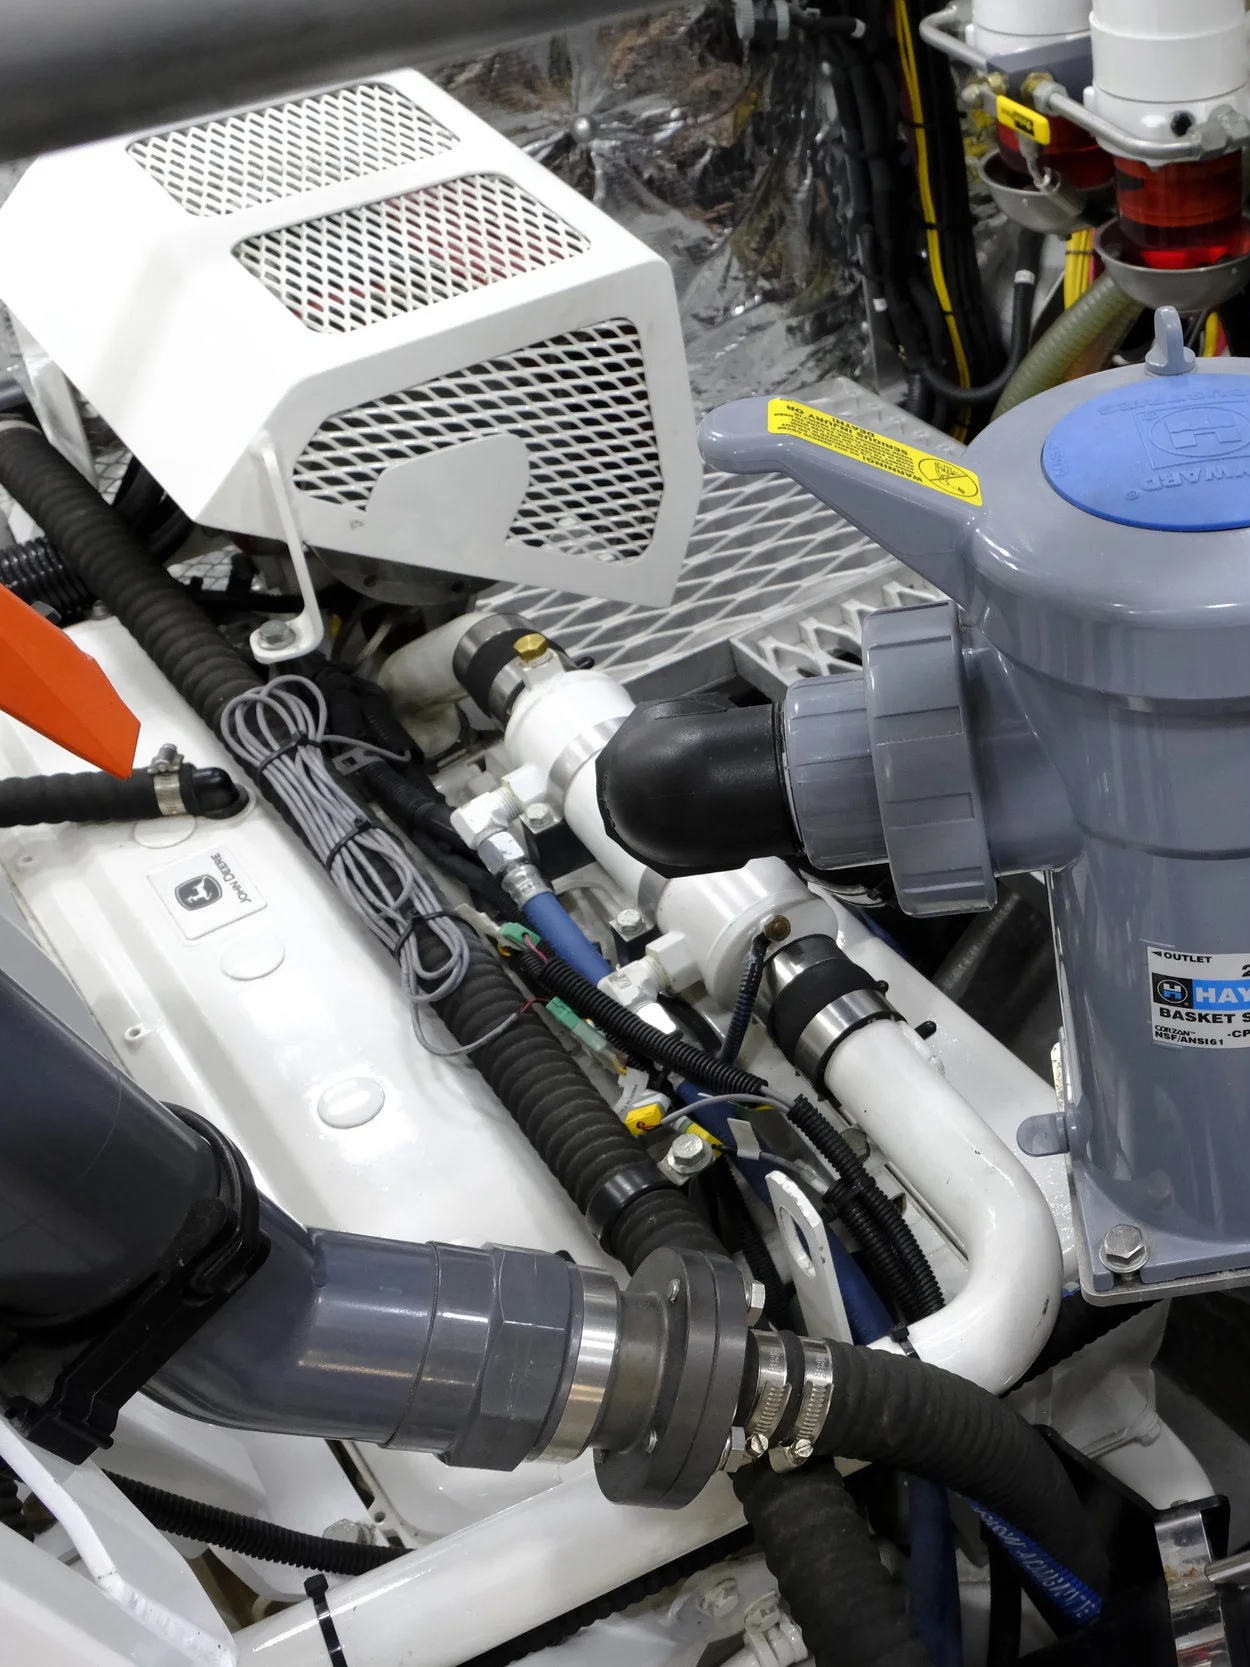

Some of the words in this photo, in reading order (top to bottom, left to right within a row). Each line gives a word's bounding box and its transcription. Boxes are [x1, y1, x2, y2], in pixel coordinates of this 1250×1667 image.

[786, 404, 804, 415] OR
[807, 412, 852, 433] INJURY
[831, 417, 874, 437] DEATH!
[856, 432, 907, 455] SERIOUS
[210, 852, 235, 882] DEERE
[229, 881, 252, 904] JOHN
[1164, 951, 1212, 964] OUTLET
[1159, 1007, 1236, 1024] BASKET
